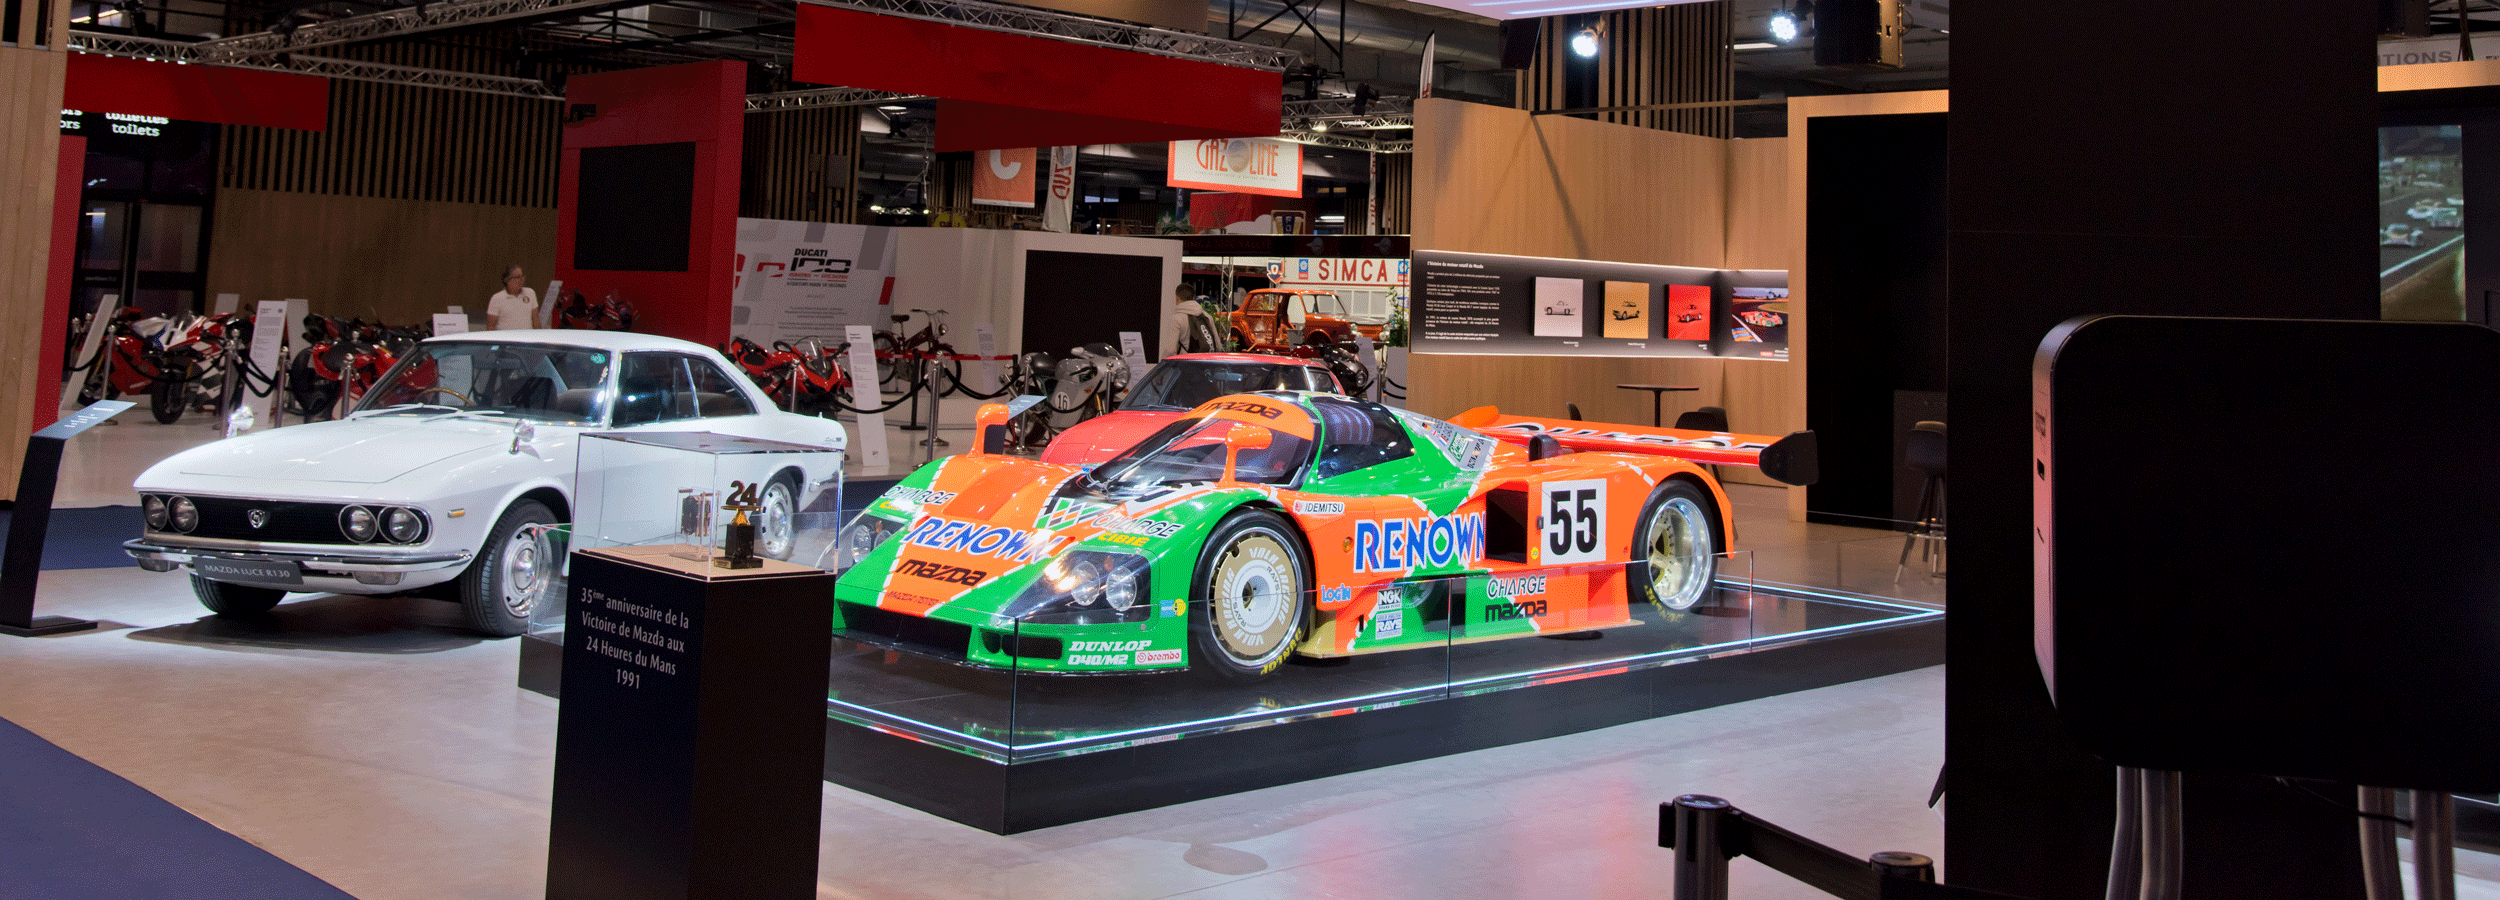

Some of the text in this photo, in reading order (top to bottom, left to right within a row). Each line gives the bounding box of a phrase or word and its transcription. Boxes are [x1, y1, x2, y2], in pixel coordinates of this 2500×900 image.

[112, 124, 160, 136] toilets
[794, 248, 828, 257] DUCATI
[1318, 258, 1388, 282] SIMCA
[1058, 394, 1068, 410] 16
[726, 480, 758, 506] 24
[1304, 502, 1344, 512] IDEMITSU
[1090, 513, 1185, 539] CHARGE
[1550, 489, 1598, 556] 55
[903, 518, 1070, 564] RENOWN
[1098, 532, 1150, 547] CIBIE
[1354, 511, 1486, 574] RENOWN
[204, 565, 290, 578] MAZDA LUCE R130
[1266, 566, 1280, 592] RAYS
[1379, 588, 1400, 605] NGK
[1486, 576, 1547, 600] CHARGE
[606, 598, 662, 622] anniversaire
[665, 609, 677, 626] de
[680, 612, 689, 628] la
[582, 610, 684, 653] Victoire de Mazda aux
[586, 636, 676, 676] 24 Heures du Mans
[1068, 640, 1152, 652] DUNLOP
[1147, 651, 1180, 662] brembo
[616, 668, 640, 689] 1991
